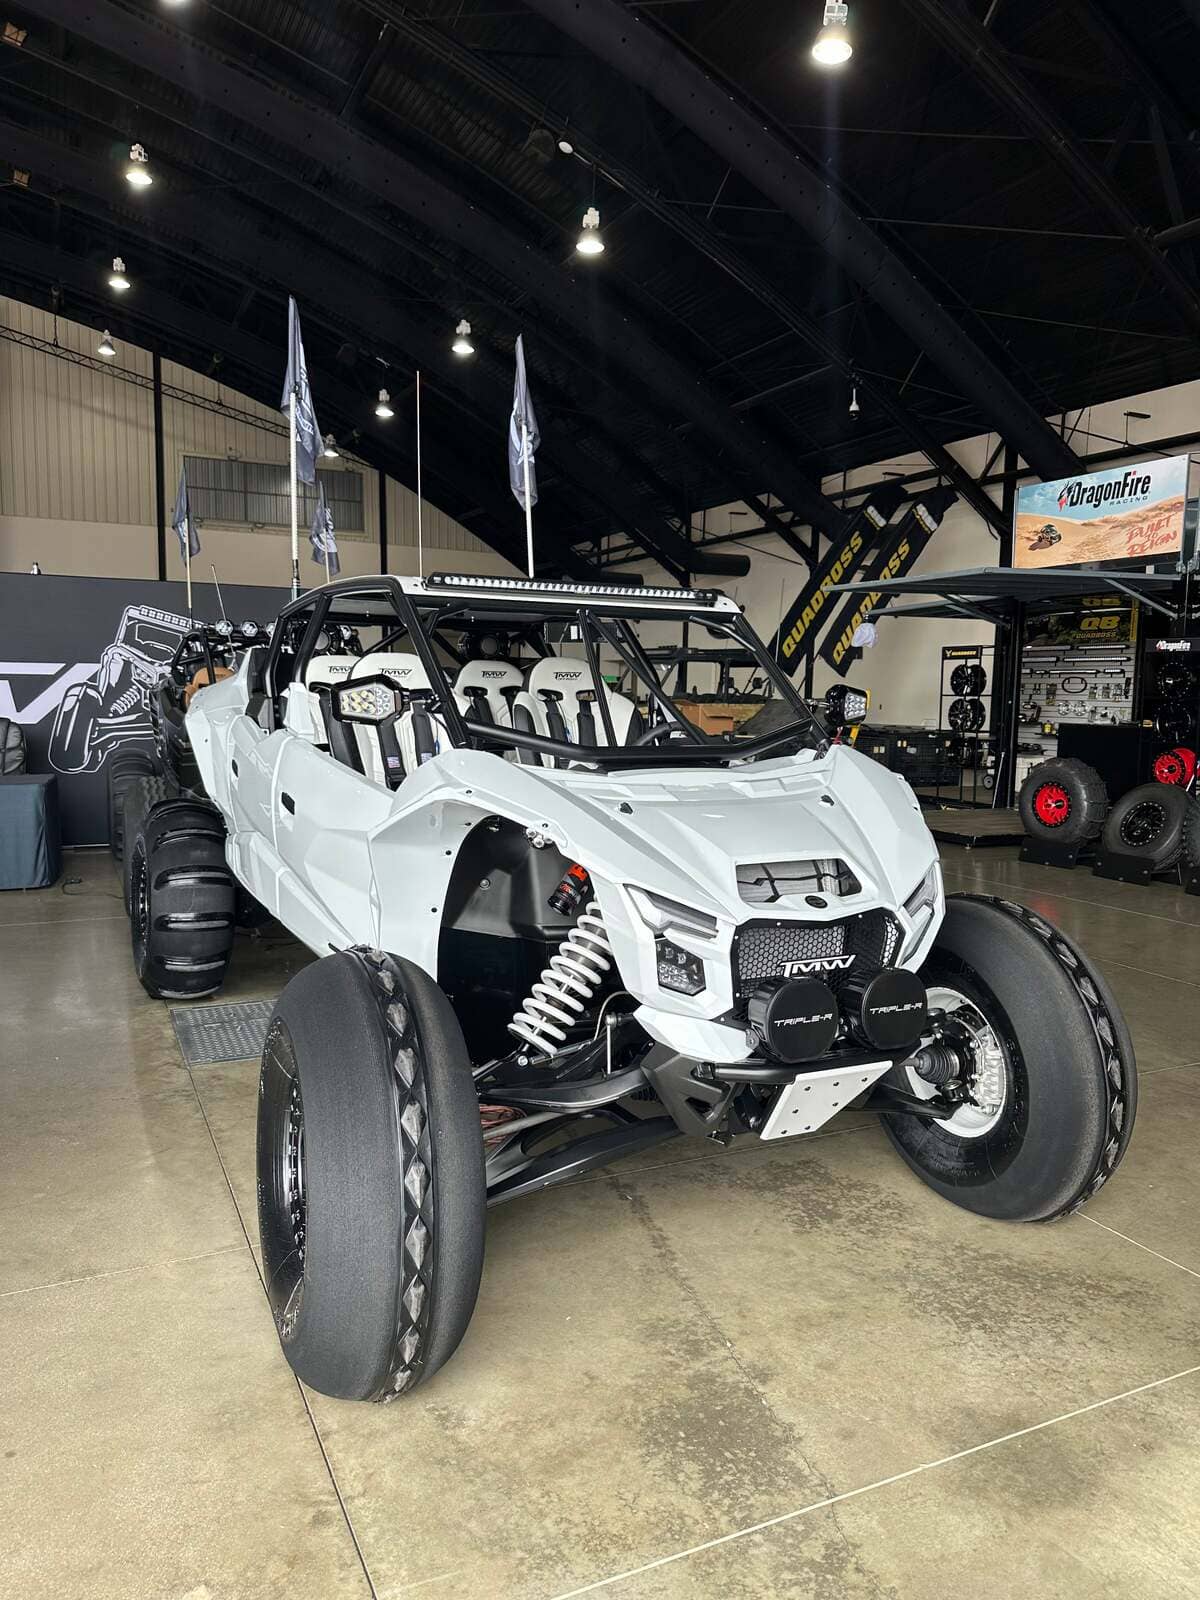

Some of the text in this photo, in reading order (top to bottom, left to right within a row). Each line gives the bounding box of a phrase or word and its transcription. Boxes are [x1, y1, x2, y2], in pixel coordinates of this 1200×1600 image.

[1069, 470, 1151, 508] DragonFire
[1109, 496, 1149, 506] RACING
[553, 671, 583, 681] TMW
[780, 954, 857, 978] TMW
[869, 1002, 923, 1015] TRIPLE-R
[774, 1013, 833, 1027] TRIPLE-R
